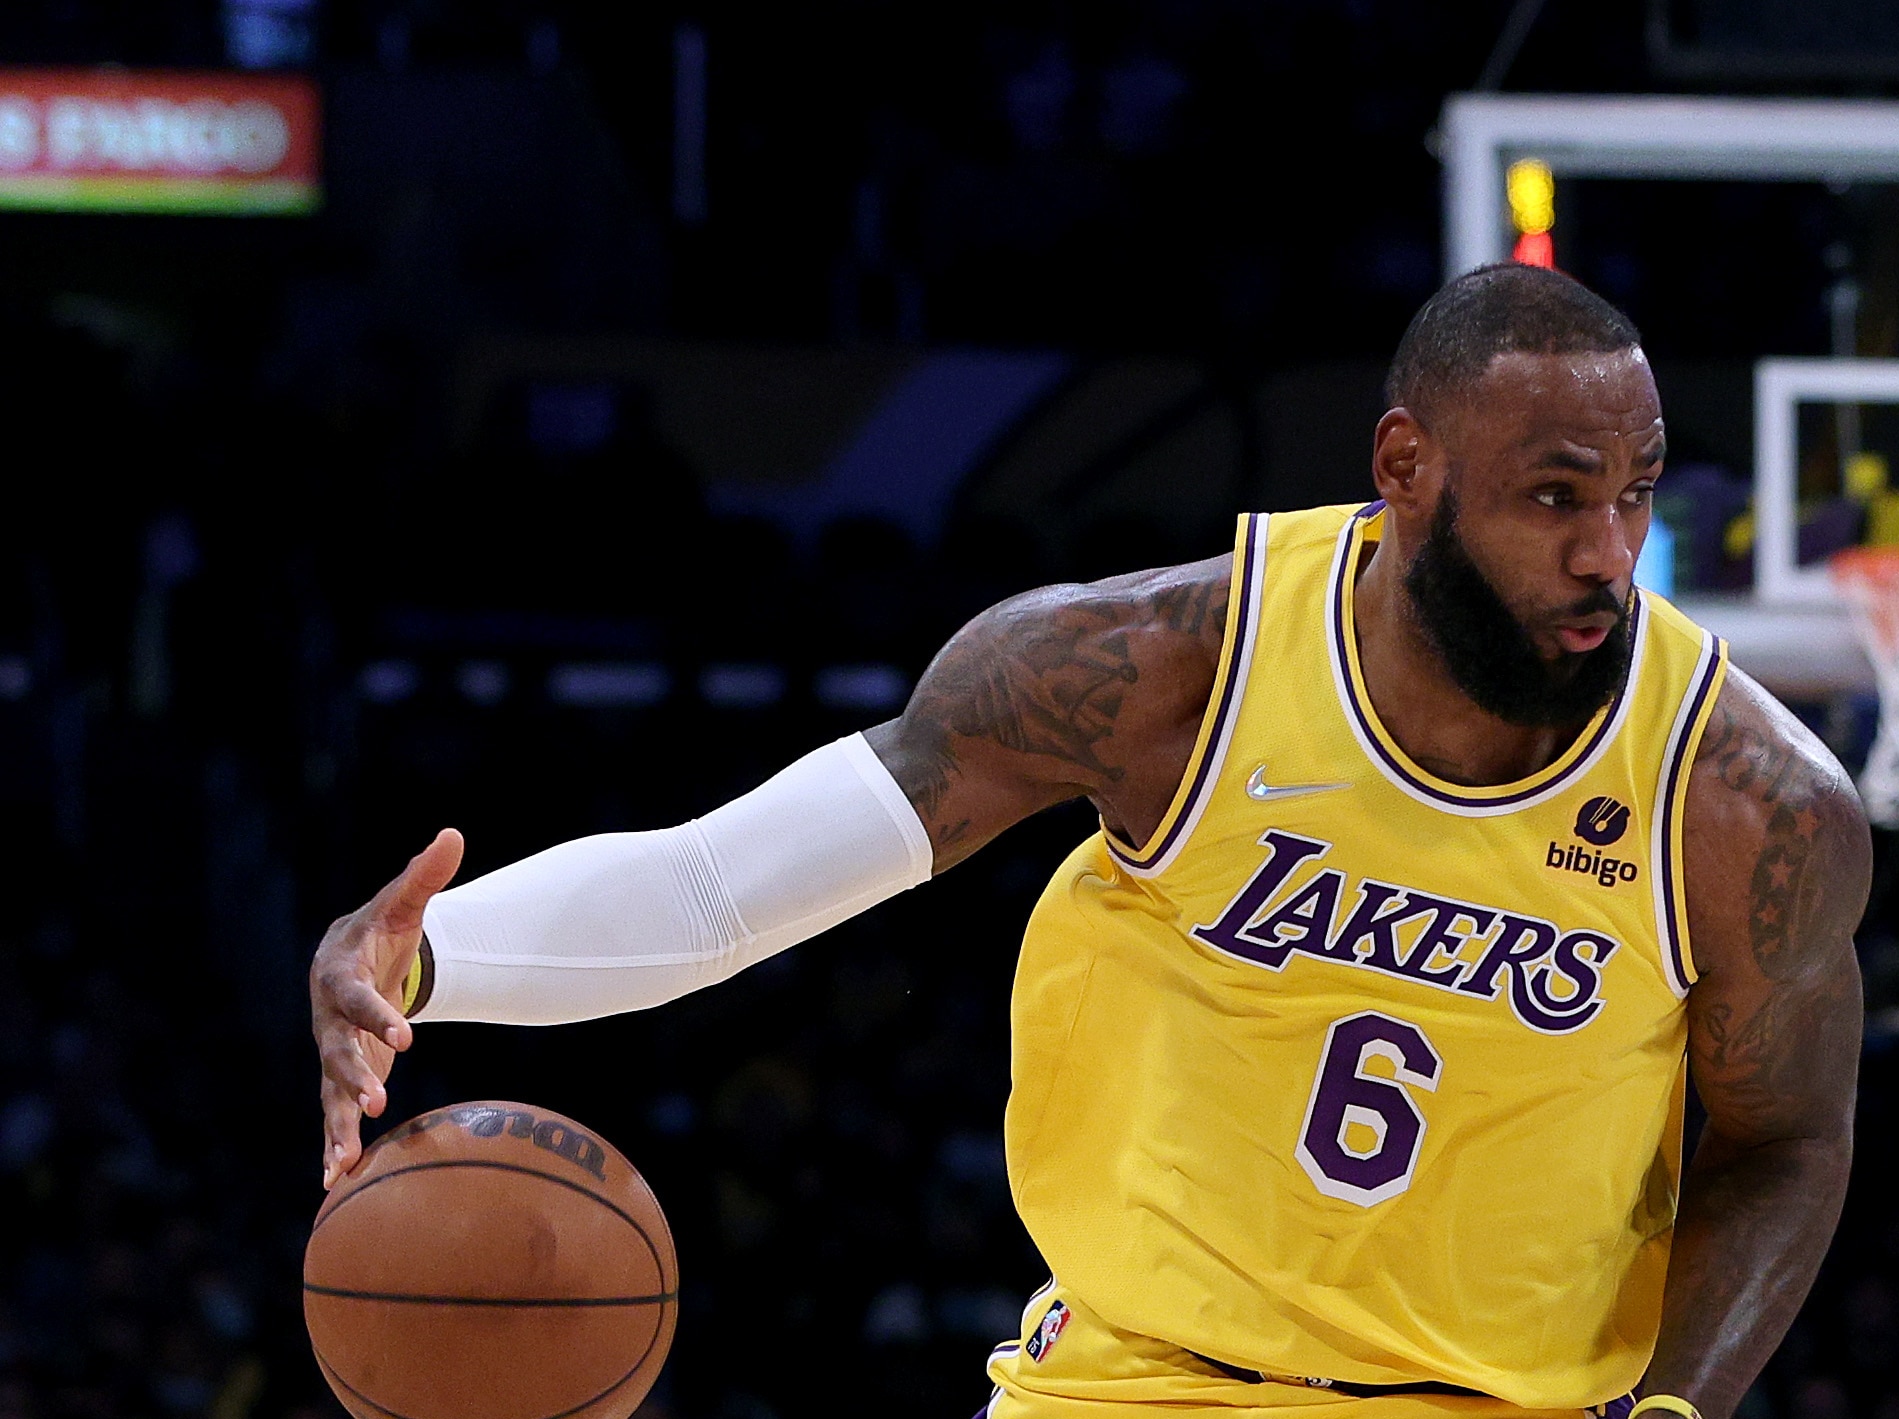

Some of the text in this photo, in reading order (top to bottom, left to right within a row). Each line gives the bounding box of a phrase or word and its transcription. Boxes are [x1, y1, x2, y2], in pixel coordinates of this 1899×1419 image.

[1188, 828, 1620, 1036] LAKERS
[1545, 840, 1638, 888] bibigo
[1294, 1009, 1445, 1209] 6
